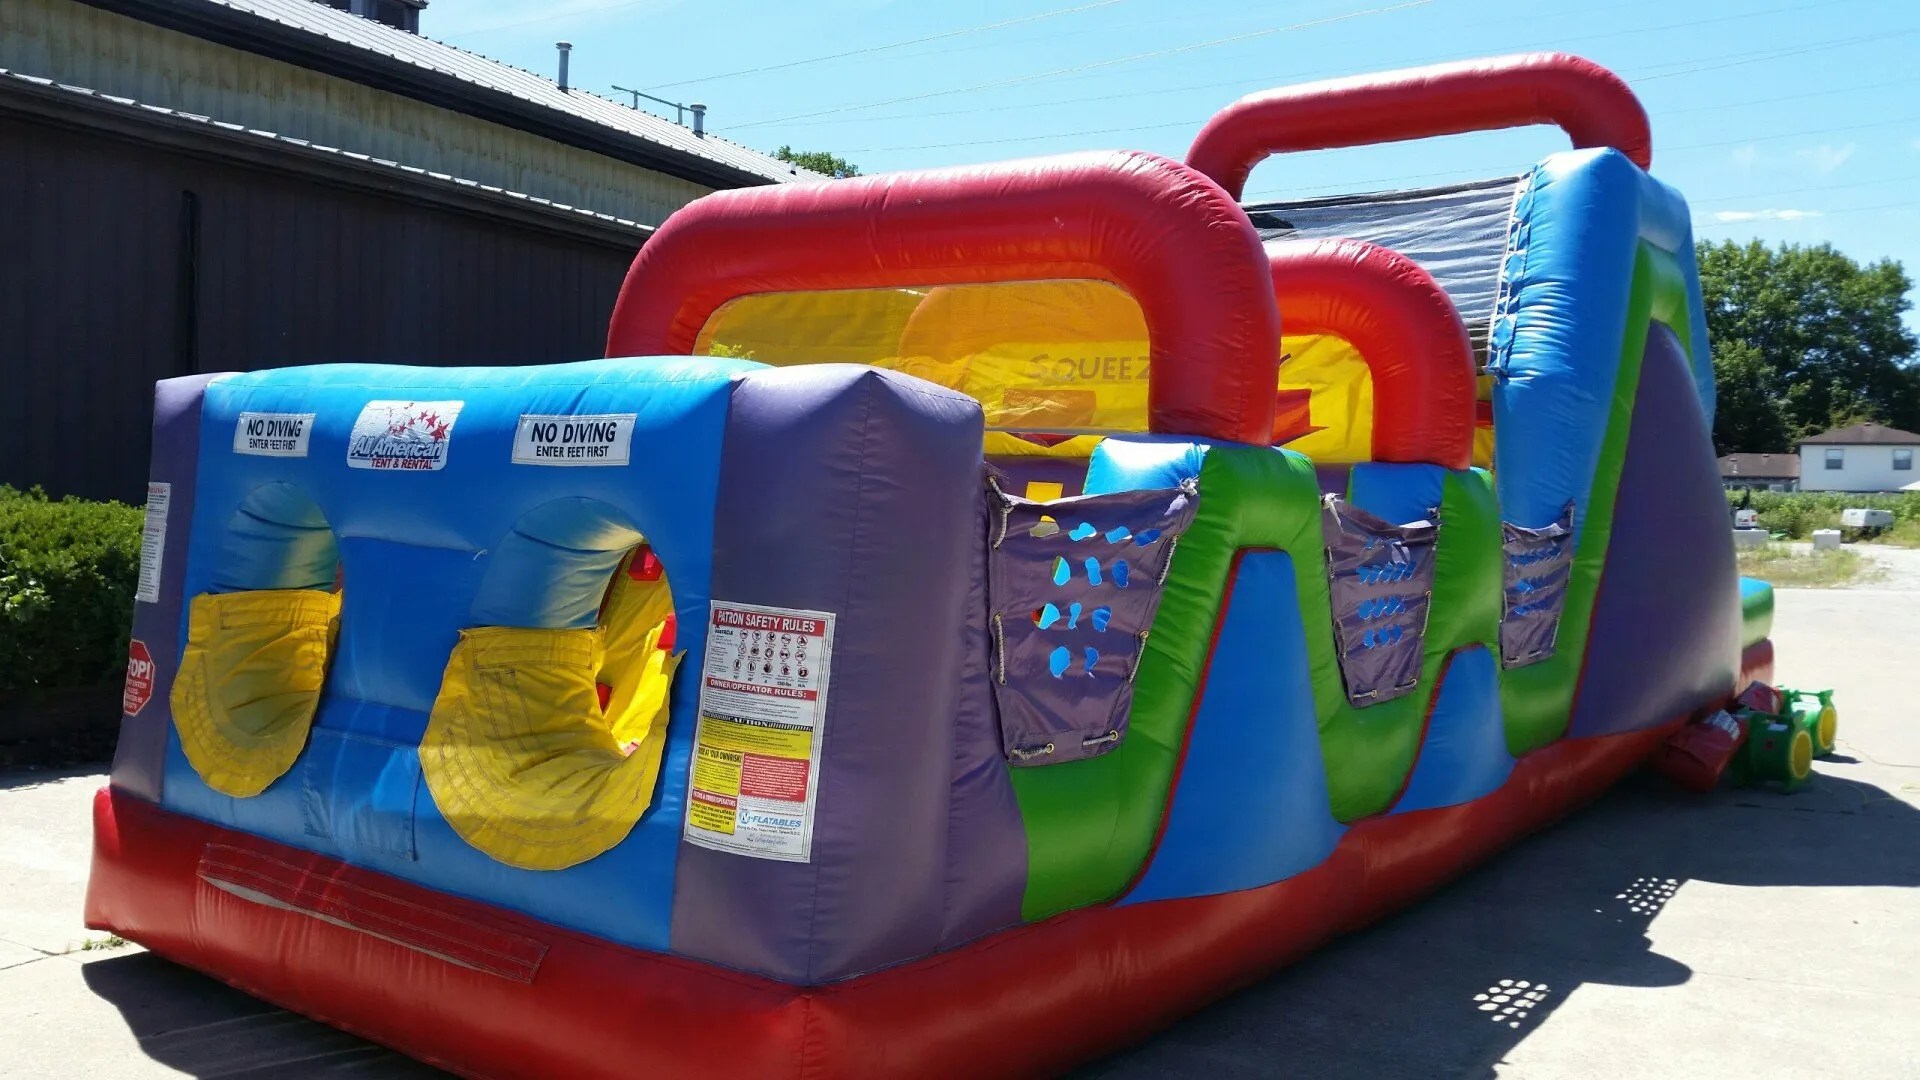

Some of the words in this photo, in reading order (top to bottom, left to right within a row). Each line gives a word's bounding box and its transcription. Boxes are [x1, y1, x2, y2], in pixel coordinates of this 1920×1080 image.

[247, 419, 264, 436] NO
[267, 420, 303, 437] DIVING
[531, 422, 558, 443] NO
[562, 422, 617, 443] DIVING
[249, 438, 269, 450] ENTER
[270, 439, 283, 450] FEET
[283, 440, 296, 451] FIRST
[351, 436, 375, 457] All
[370, 438, 444, 459] American
[536, 446, 564, 457] ENTER
[567, 446, 586, 458] FEET
[587, 445, 609, 457] FIRST
[371, 458, 392, 469] TENT
[393, 459, 400, 469] &
[400, 459, 433, 470] RENTAL
[718, 611, 744, 625] PATRON
[746, 614, 780, 629] SAFETY
[783, 619, 815, 632] RULES
[710, 679, 772, 694] OWNER/OPERATOR
[774, 688, 807, 699] RULES:
